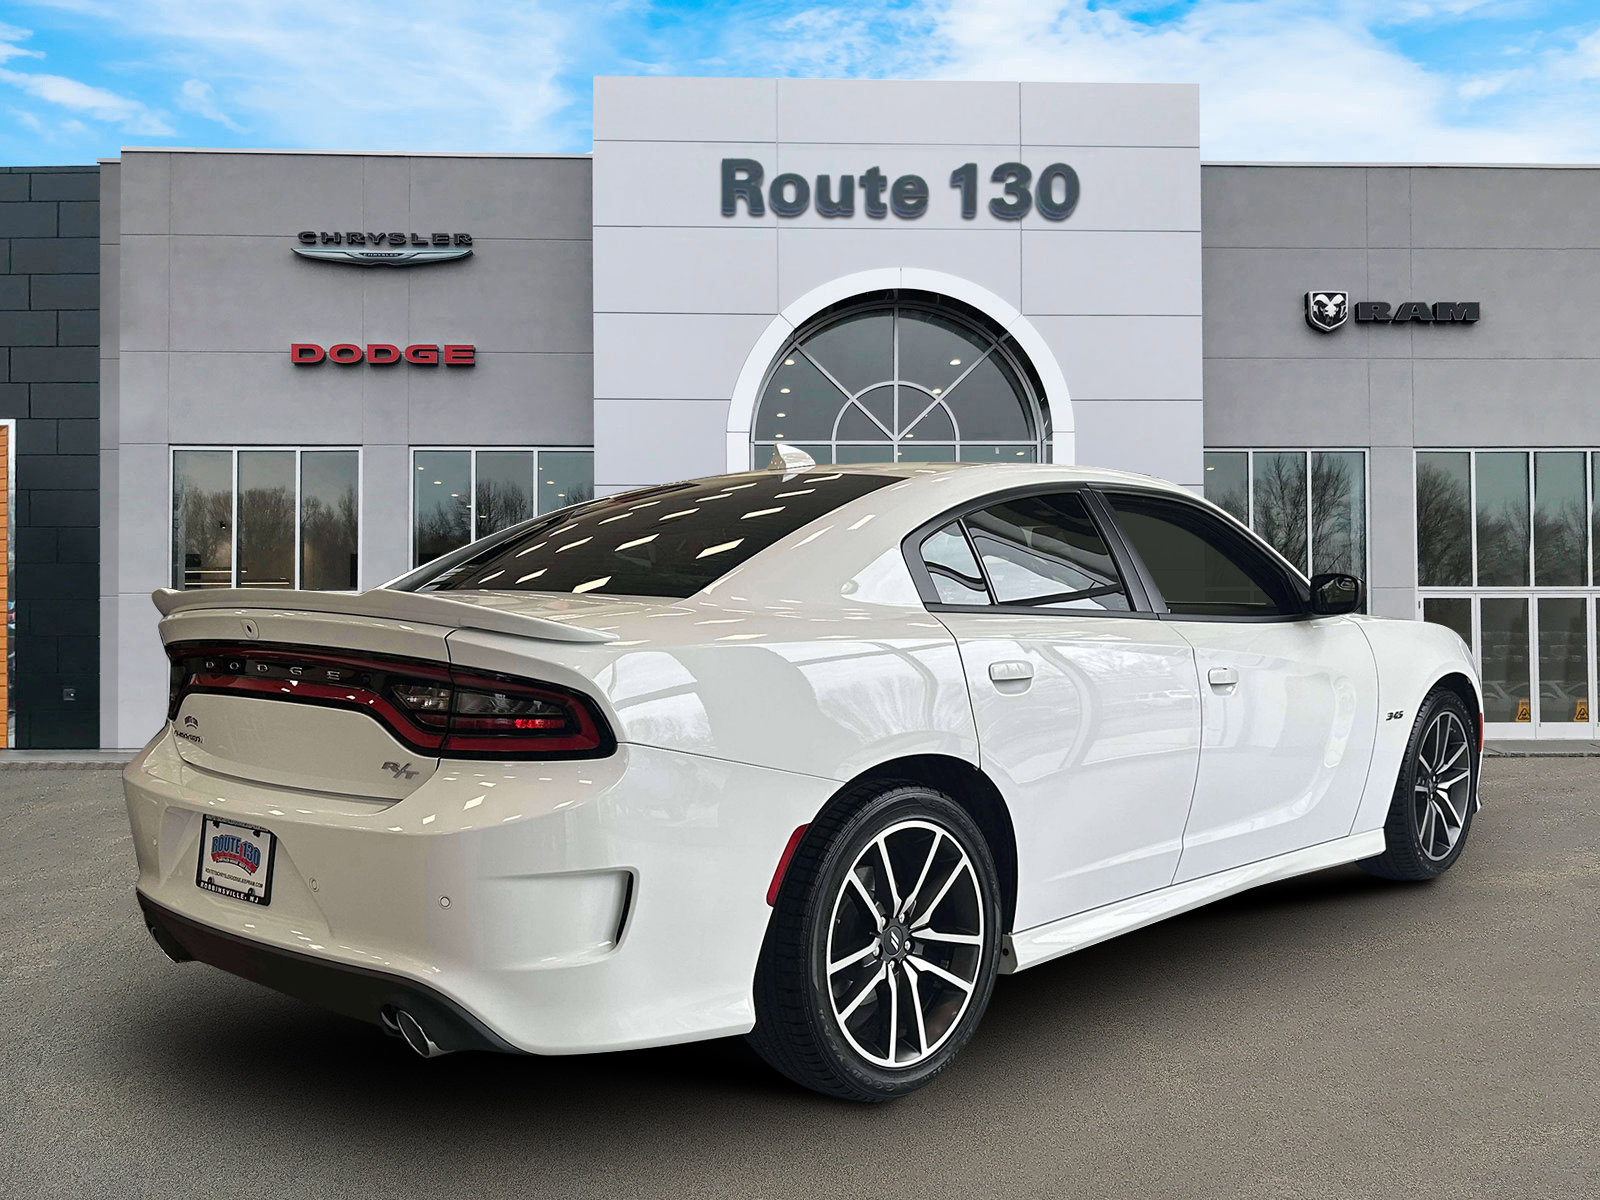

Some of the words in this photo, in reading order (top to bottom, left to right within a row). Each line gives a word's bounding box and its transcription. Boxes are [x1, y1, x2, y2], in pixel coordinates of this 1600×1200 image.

[721, 158, 930, 217] Route
[950, 162, 1080, 221] 130
[298, 231, 473, 245] CHRYSLER
[1354, 302, 1480, 323] RAM
[291, 343, 475, 364] DODGE
[205, 661, 341, 681] DODGE
[1385, 710, 1404, 721] 345
[381, 761, 419, 779] R/T
[211, 834, 241, 855] ROUTE
[241, 841, 262, 867] 130
[249, 896, 259, 904] NJ
